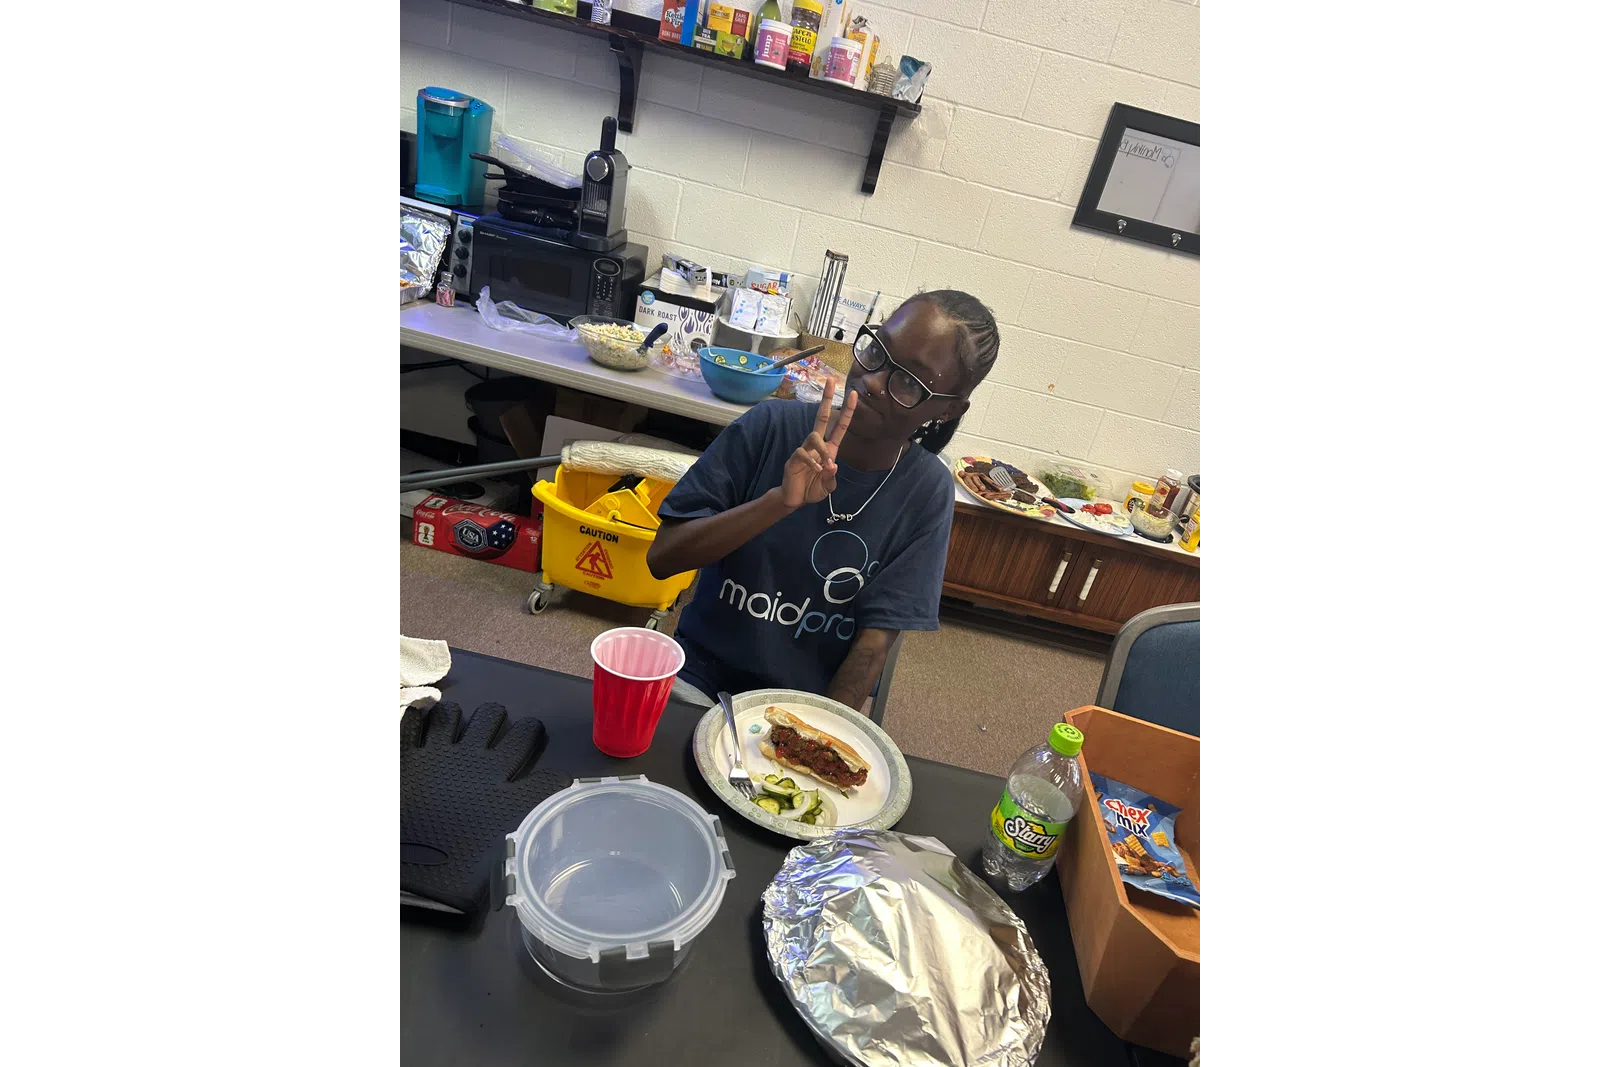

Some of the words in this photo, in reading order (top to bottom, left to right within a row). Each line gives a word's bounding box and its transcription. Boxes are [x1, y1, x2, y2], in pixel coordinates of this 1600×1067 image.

[638, 305, 655, 316] DARK
[658, 311, 677, 321] ROAST
[842, 298, 866, 310] ALWAYS
[462, 528, 479, 542] USA
[579, 525, 619, 543] CAUTION
[1104, 799, 1151, 824] Chex
[1116, 812, 1148, 838] mix
[1005, 817, 1056, 853] Starry
